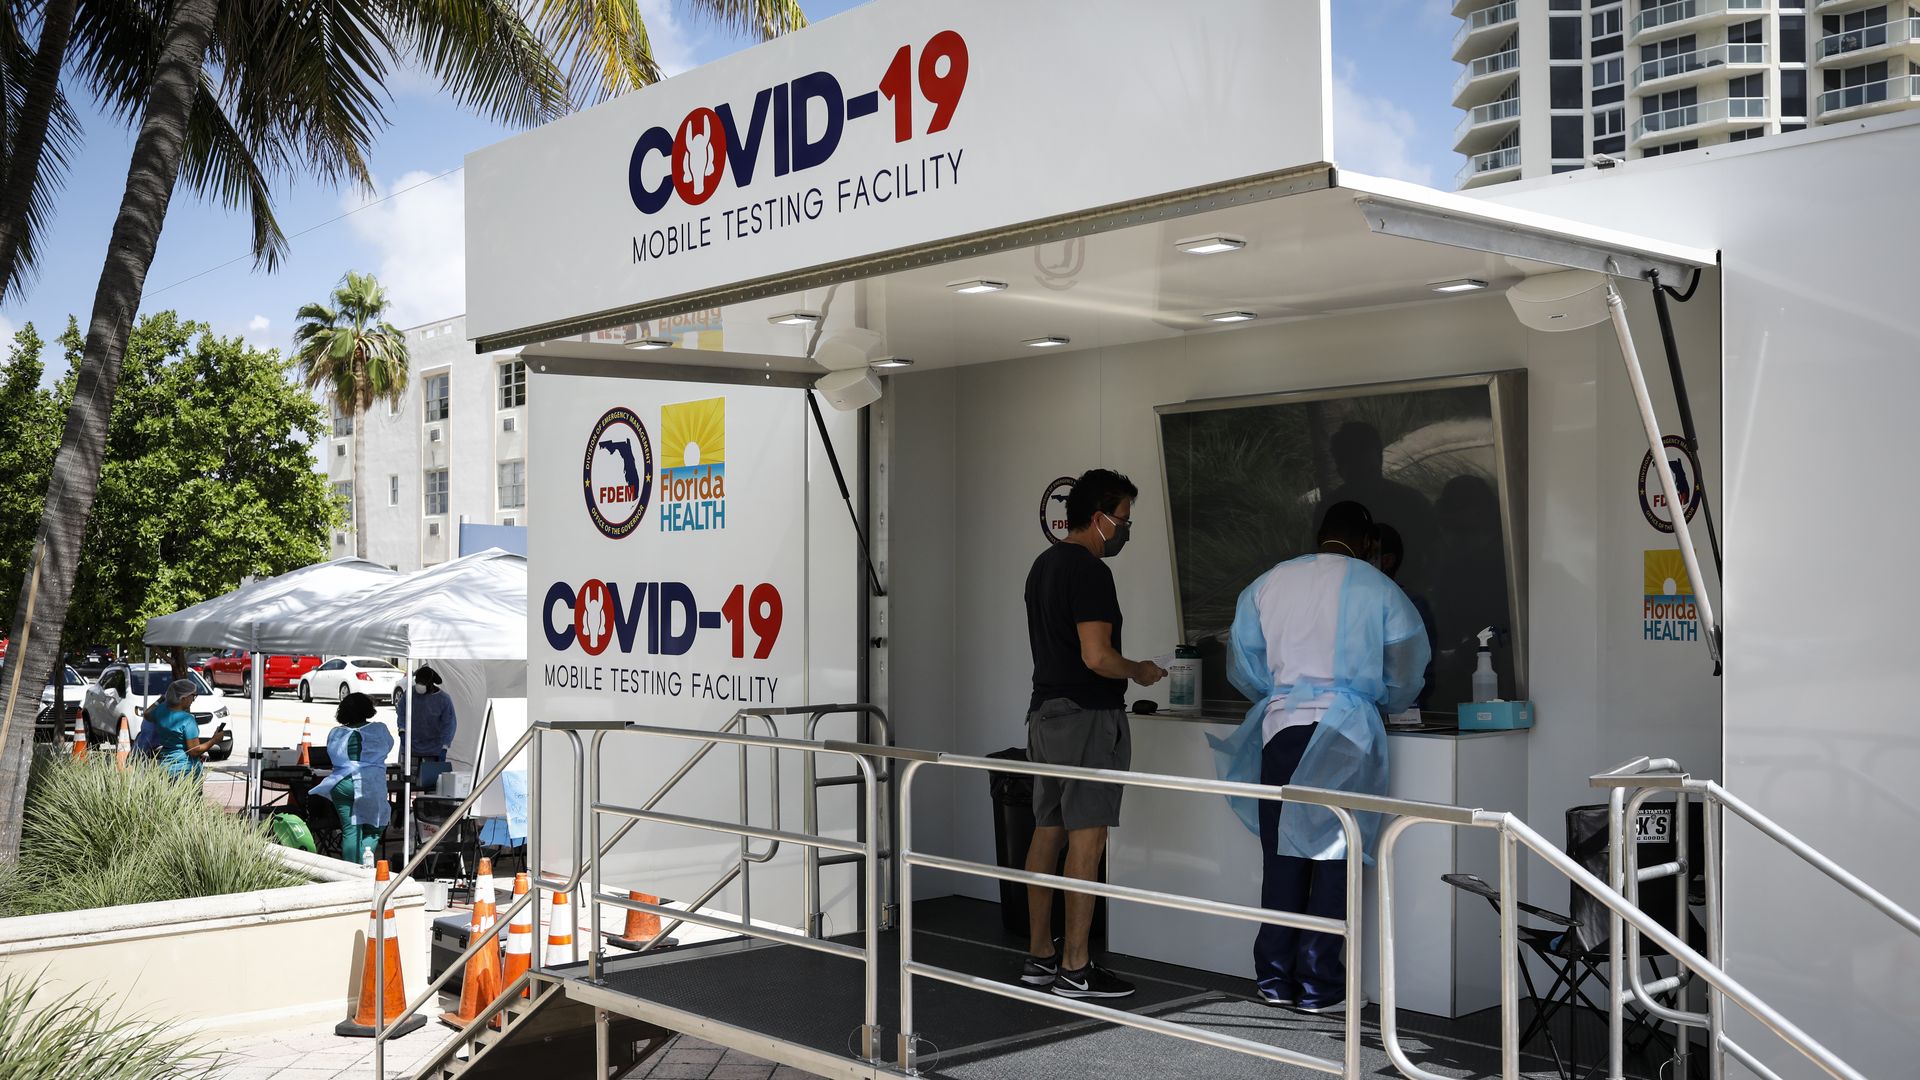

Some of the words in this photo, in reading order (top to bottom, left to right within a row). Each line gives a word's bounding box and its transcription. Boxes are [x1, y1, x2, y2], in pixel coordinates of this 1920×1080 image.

[628, 30, 969, 215] COVID-19
[633, 216, 711, 264] MOBILE
[723, 188, 824, 241] TESTING
[838, 149, 963, 213] FACILITY
[585, 433, 598, 470] DIVISION
[601, 411, 629, 427] EMERGENCY
[629, 416, 651, 465] MANAGEMENT
[600, 485, 635, 504] FDEM
[660, 466, 725, 502] Florida
[591, 507, 604, 529] OFFICE
[611, 527, 621, 535] THE
[620, 504, 645, 534] GOVERNOR
[660, 500, 726, 532] HEALTH
[542, 578, 783, 659] COVID-19
[1644, 594, 1697, 620] Florida
[1644, 620, 1697, 641] HEALTH
[544, 663, 602, 690] MOBILE
[611, 668, 682, 696] TESTING
[692, 673, 778, 704] FACILITY
